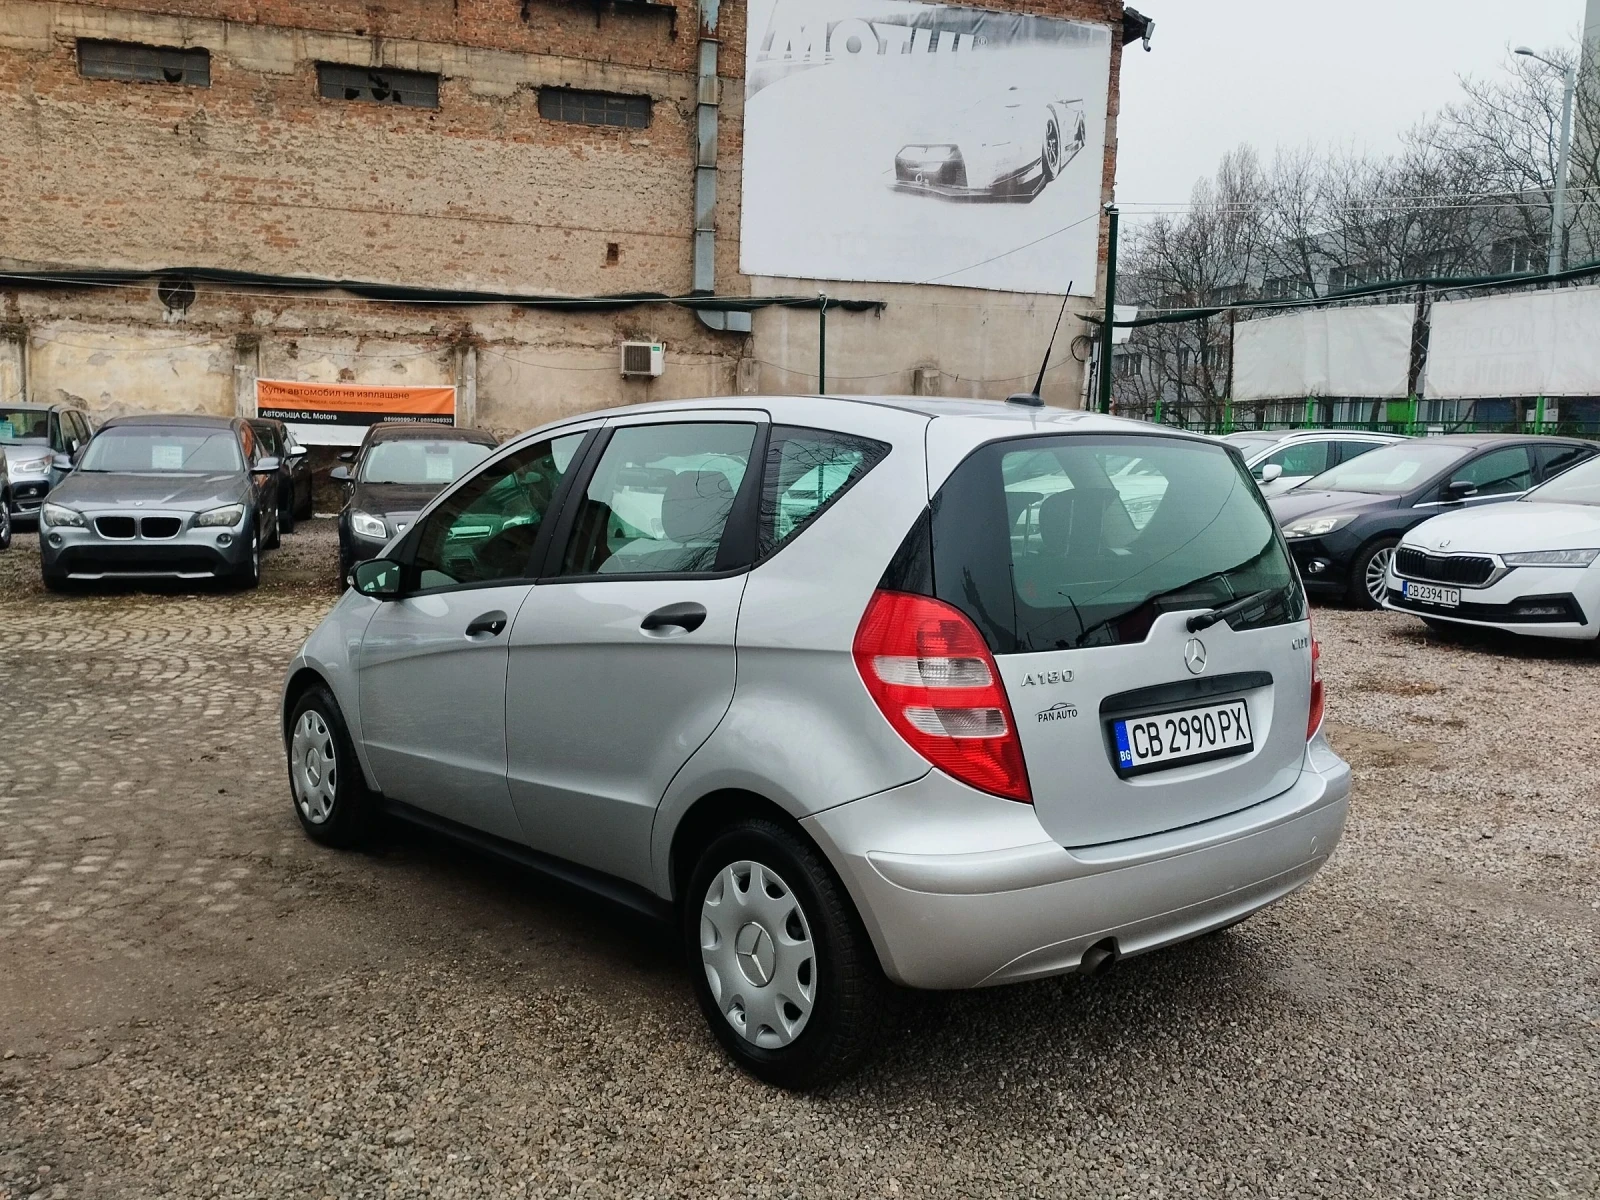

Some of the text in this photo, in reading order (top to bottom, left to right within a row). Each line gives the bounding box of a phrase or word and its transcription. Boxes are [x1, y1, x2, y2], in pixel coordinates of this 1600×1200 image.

[262, 385, 410, 400] Купи автомобил на изплащане
[262, 410, 300, 419] АВТОКЪЩА
[313, 412, 337, 421] Motors
[1408, 584, 1419, 596] CB
[1420, 586, 1442, 601] 2394
[1444, 590, 1457, 602] TC
[1021, 668, 1075, 687] A180
[1038, 709, 1078, 723] PAN AUTO
[1131, 707, 1246, 759] CB 2990 PX
[1119, 749, 1131, 762] BG
